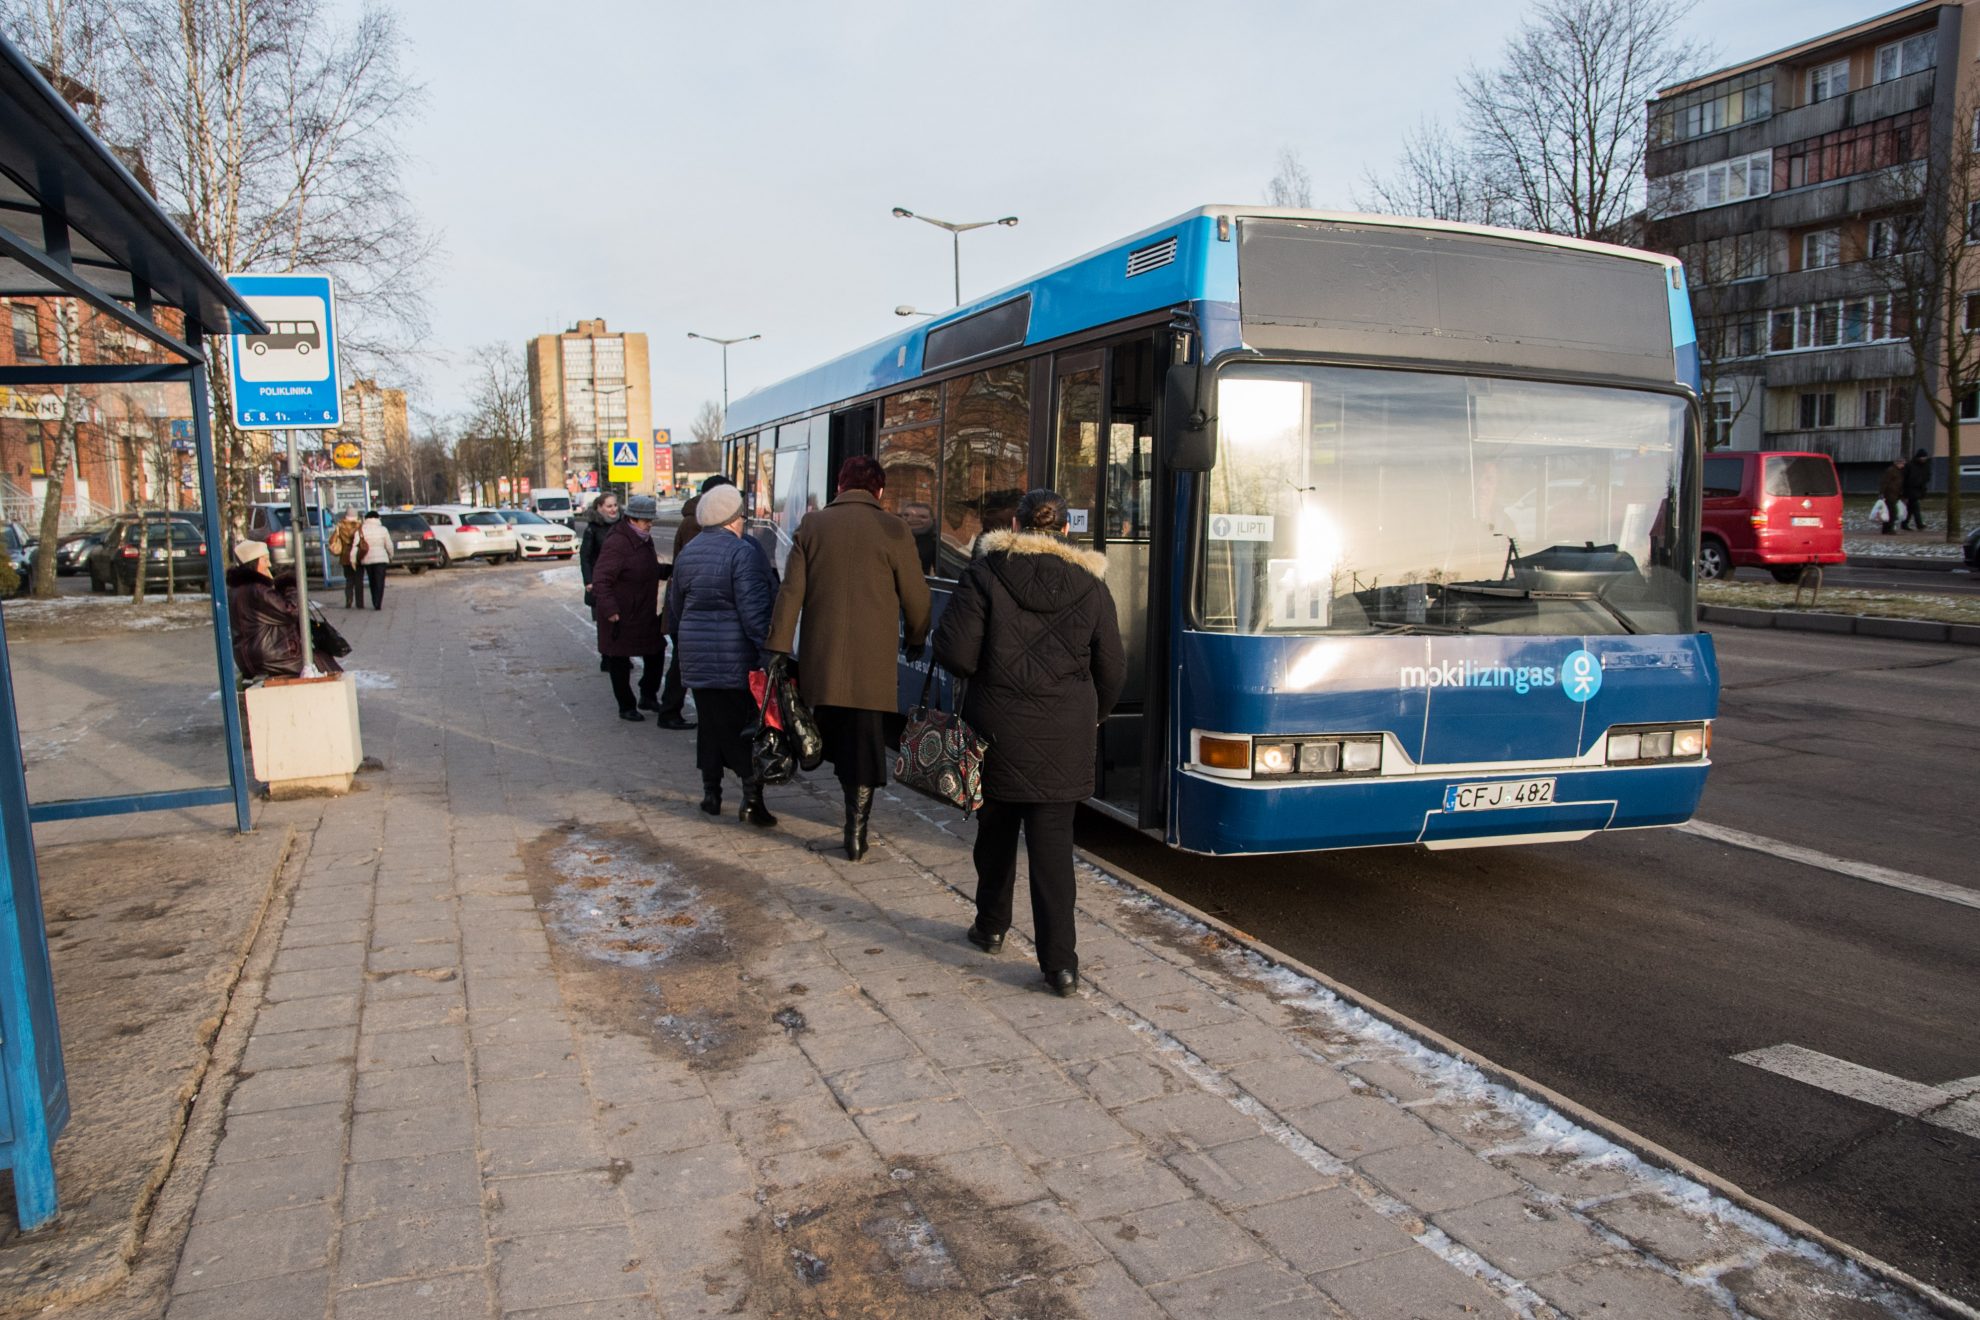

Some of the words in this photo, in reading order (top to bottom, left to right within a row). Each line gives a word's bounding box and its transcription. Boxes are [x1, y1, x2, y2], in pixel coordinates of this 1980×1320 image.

[259, 387, 313, 396] POLIKLINIKA
[259, 412, 270, 422] 8.
[1237, 522, 1266, 536] ĮLIPTI
[1400, 659, 1556, 694] mokilizingas
[1459, 786, 1503, 808] CFJ
[1515, 783, 1551, 803] 482
